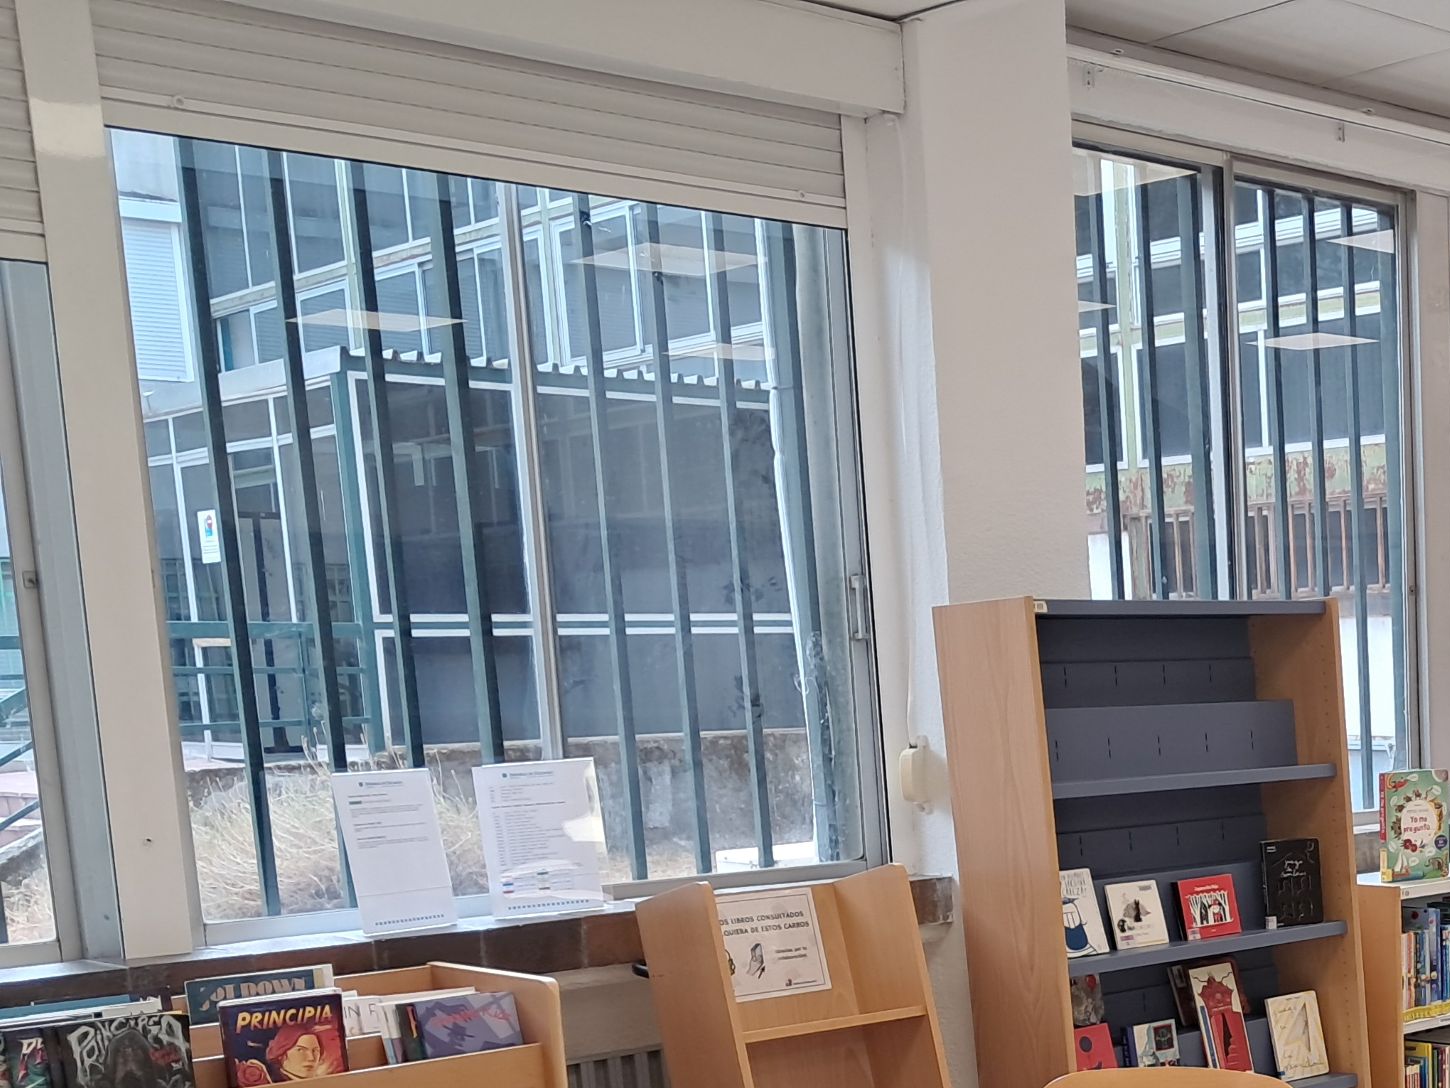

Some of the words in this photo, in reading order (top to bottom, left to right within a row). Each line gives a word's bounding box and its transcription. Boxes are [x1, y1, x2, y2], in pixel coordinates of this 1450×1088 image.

[1403, 823, 1431, 834] pregunto
[730, 915, 755, 925] LIBROS
[756, 910, 804, 922] CONSULTADOS
[723, 927, 749, 937] QUIERA
[761, 924, 782, 933] ESTOS
[783, 920, 810, 930] CARROS
[235, 1004, 333, 1034] PRINCIPIA
